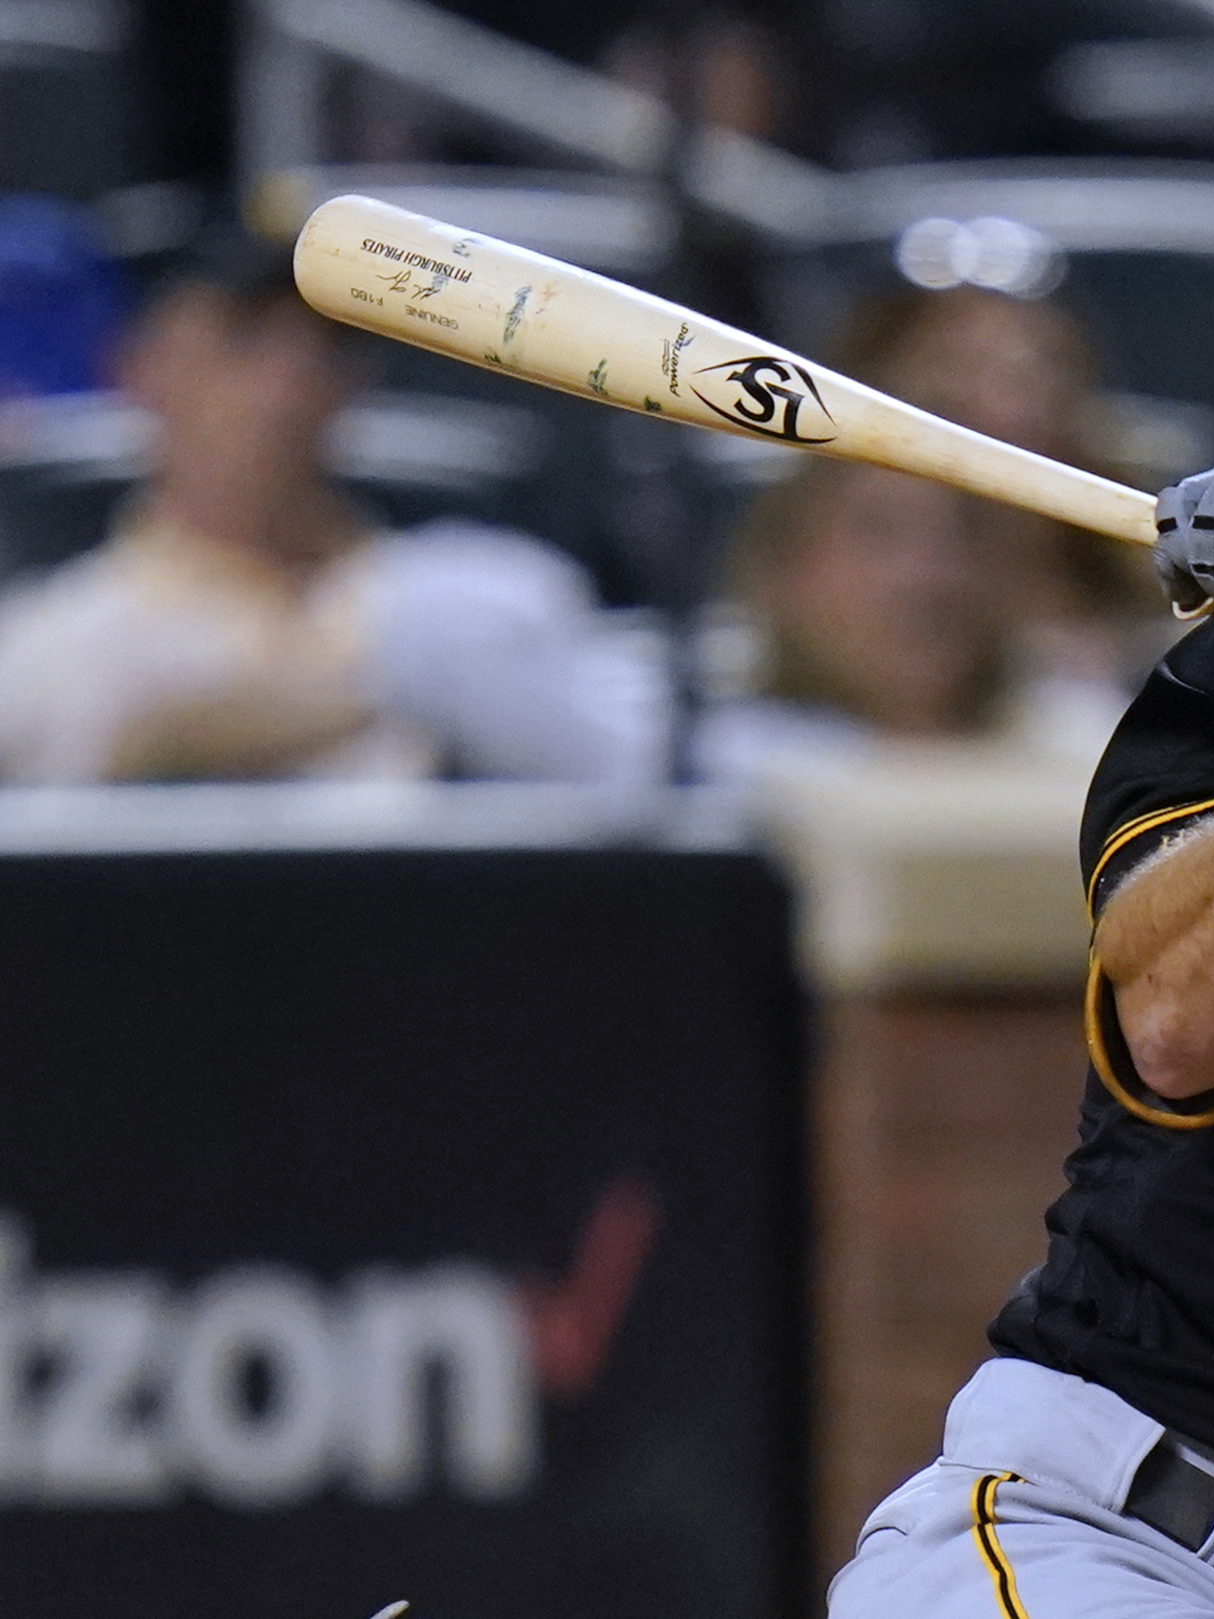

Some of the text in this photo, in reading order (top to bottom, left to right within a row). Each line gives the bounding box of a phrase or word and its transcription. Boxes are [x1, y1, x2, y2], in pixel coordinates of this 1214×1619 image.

[360, 238, 473, 284] PITTSBURGH PIRATES
[404, 304, 459, 331] GENUINE
